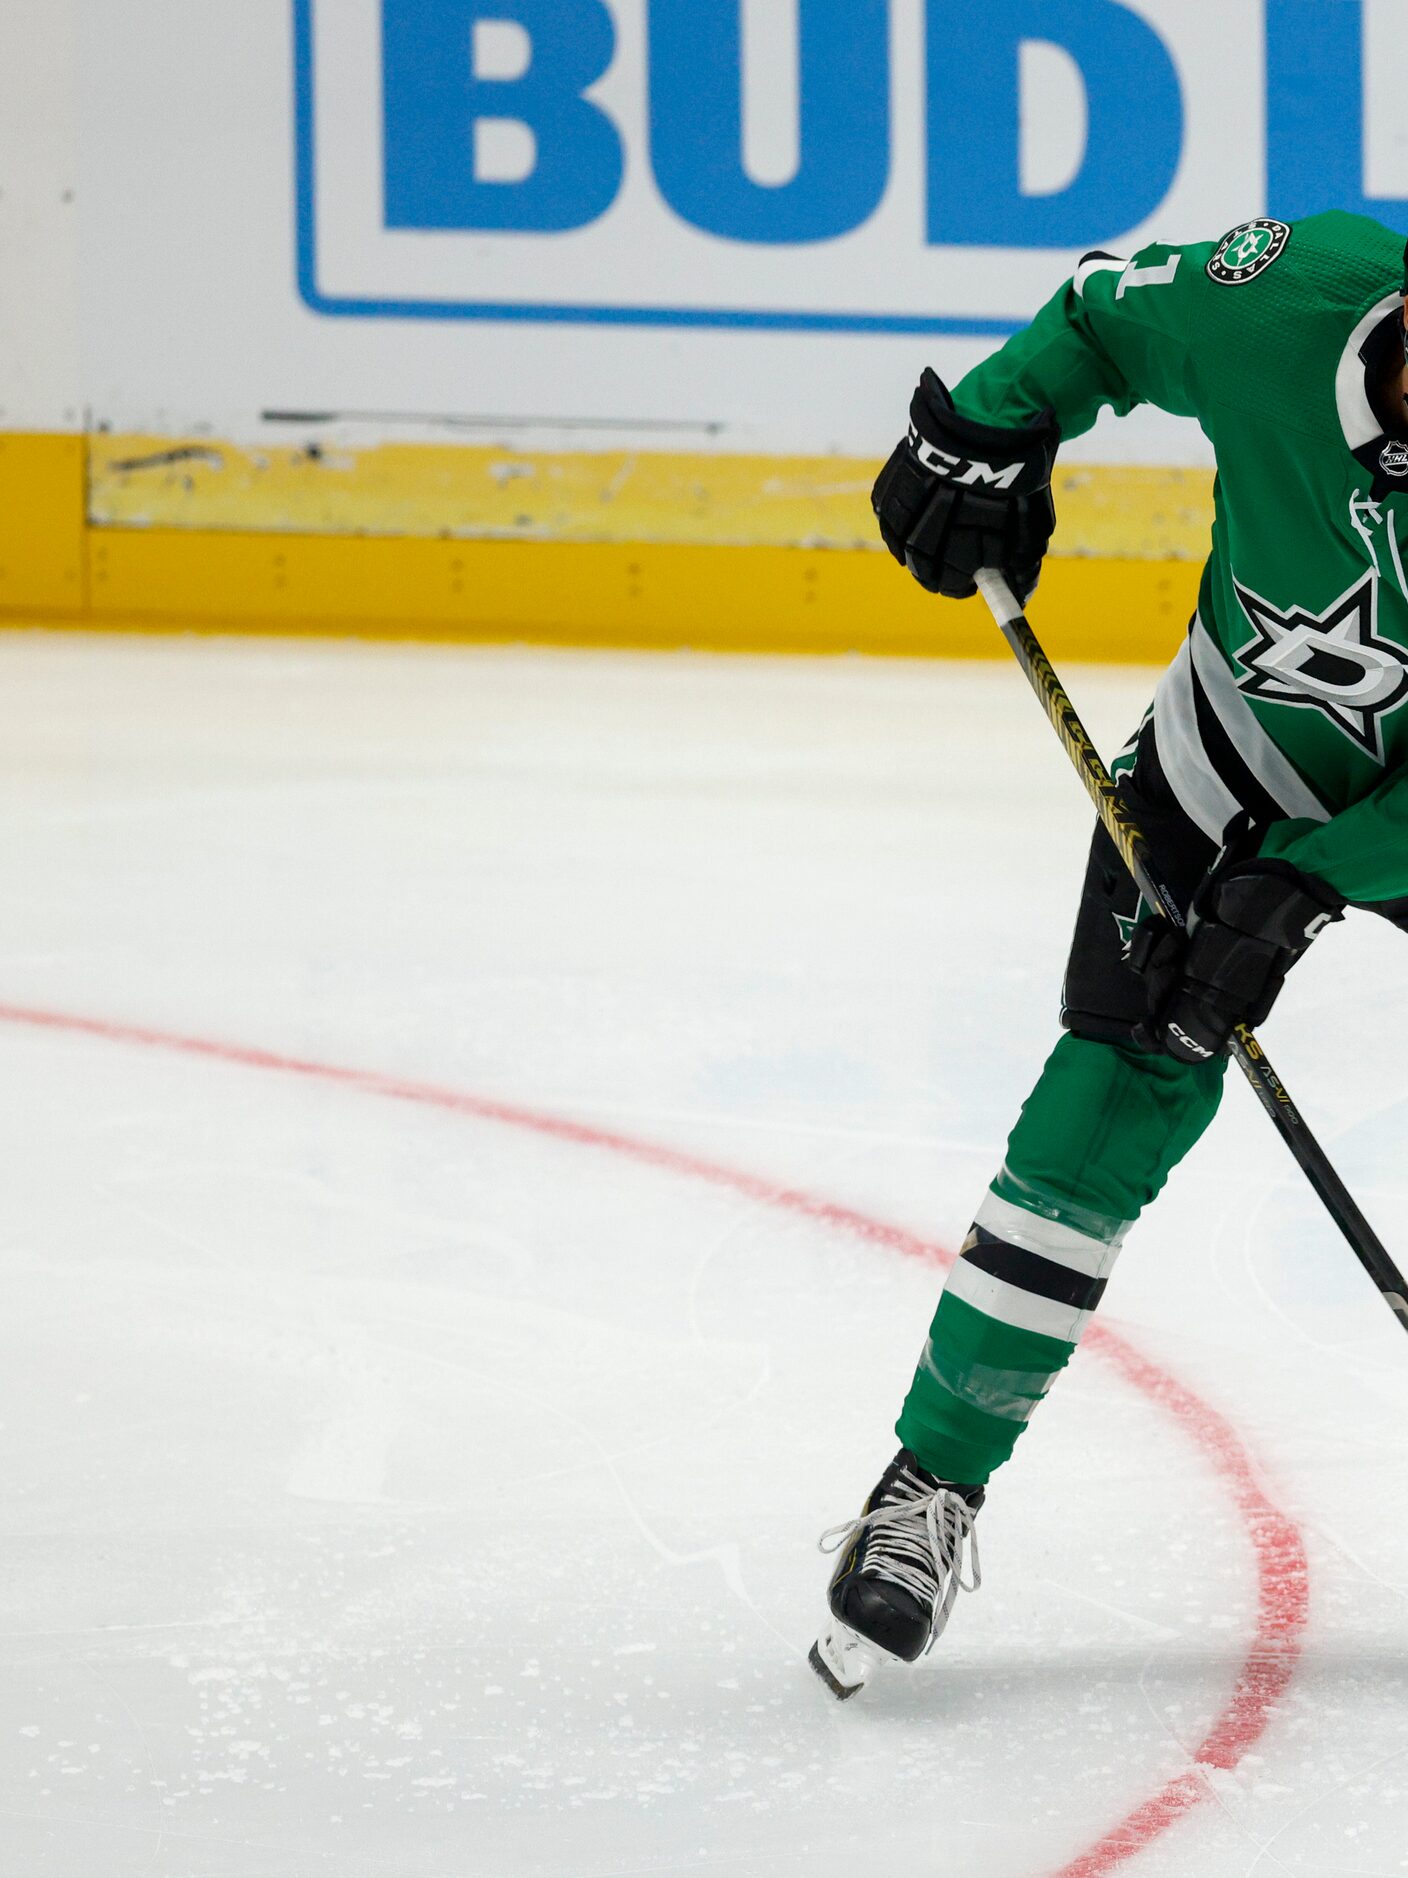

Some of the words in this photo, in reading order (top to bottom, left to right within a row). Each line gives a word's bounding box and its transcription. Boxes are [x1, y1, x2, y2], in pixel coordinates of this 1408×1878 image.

[379, 0, 1188, 251] BUD
[1232, 224, 1284, 280] DALLAS
[1385, 454, 1408, 464] NHL
[1167, 1022, 1215, 1058] CCM
